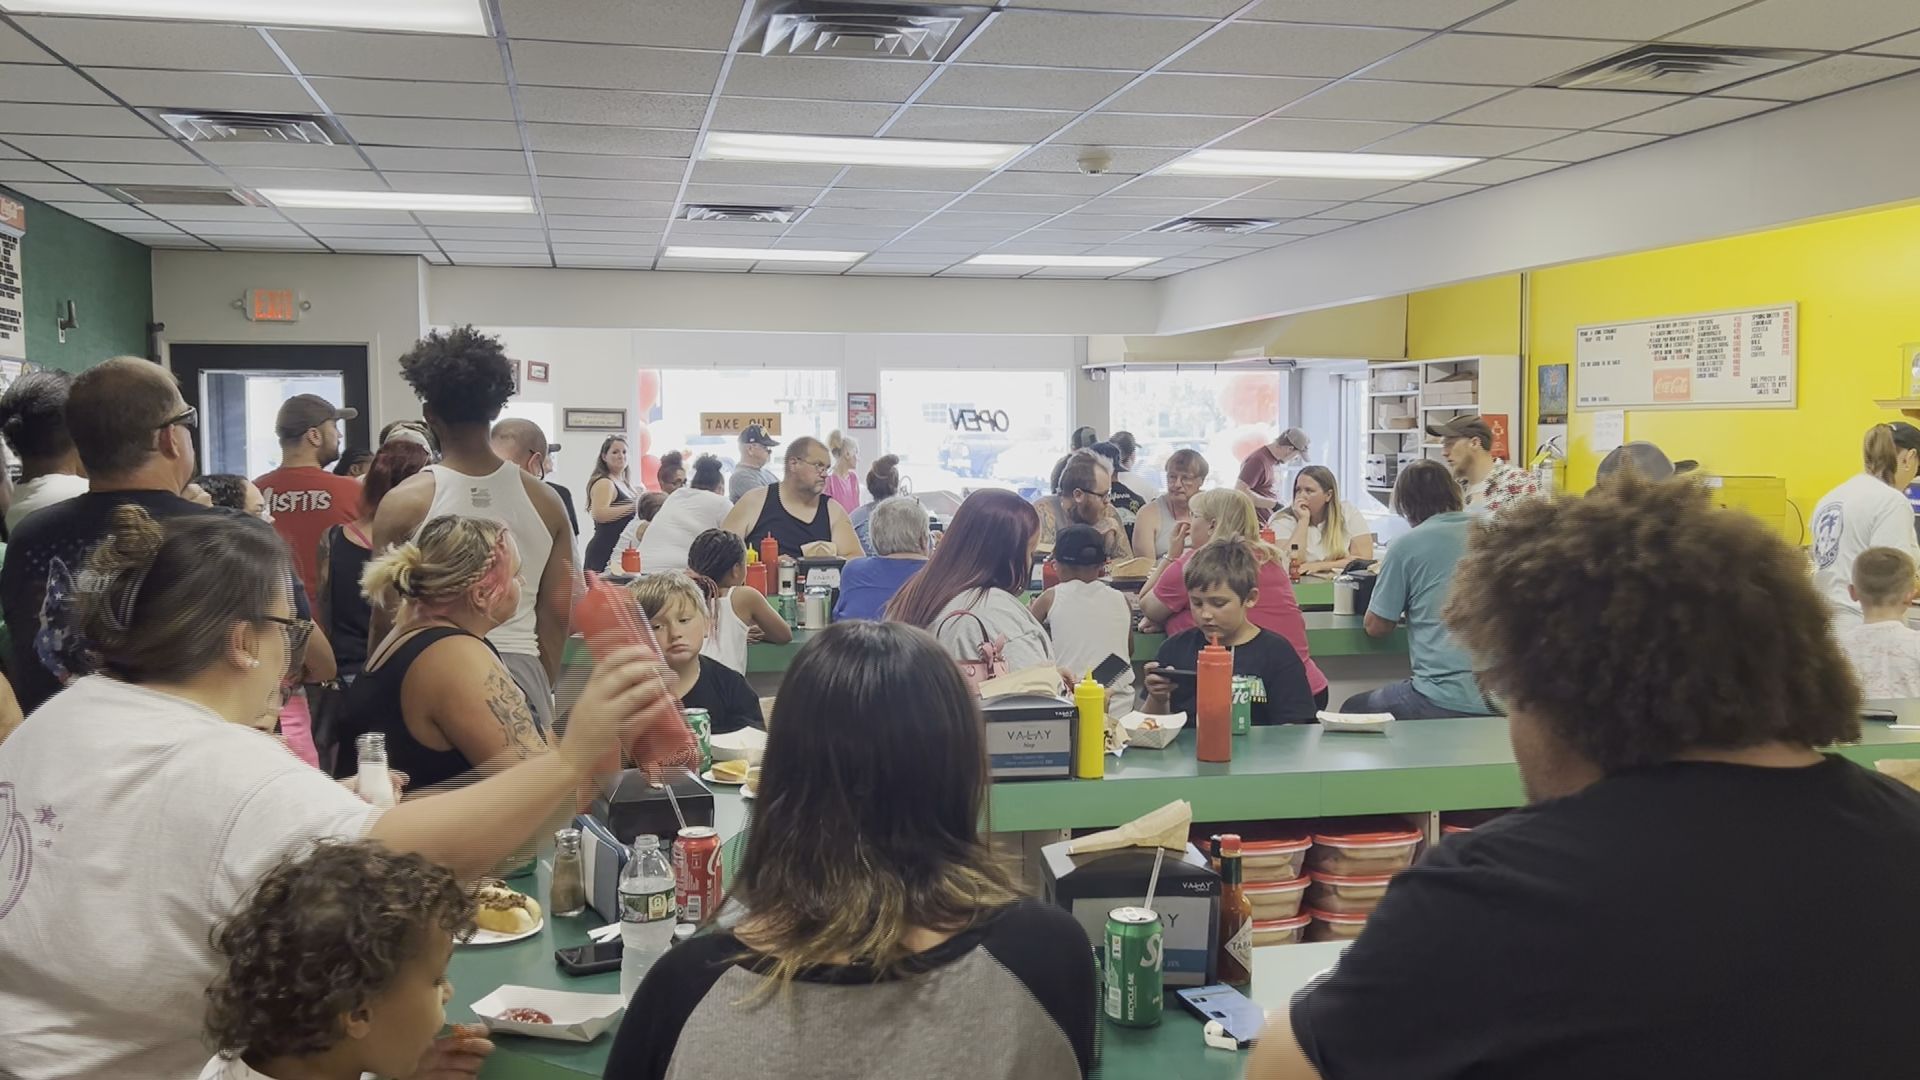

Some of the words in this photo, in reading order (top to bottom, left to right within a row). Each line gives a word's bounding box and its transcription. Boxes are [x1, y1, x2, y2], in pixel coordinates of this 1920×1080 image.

[254, 288, 293, 319] EXIT
[705, 418, 740, 430] TAKE
[1007, 730, 1051, 740] VALAY
